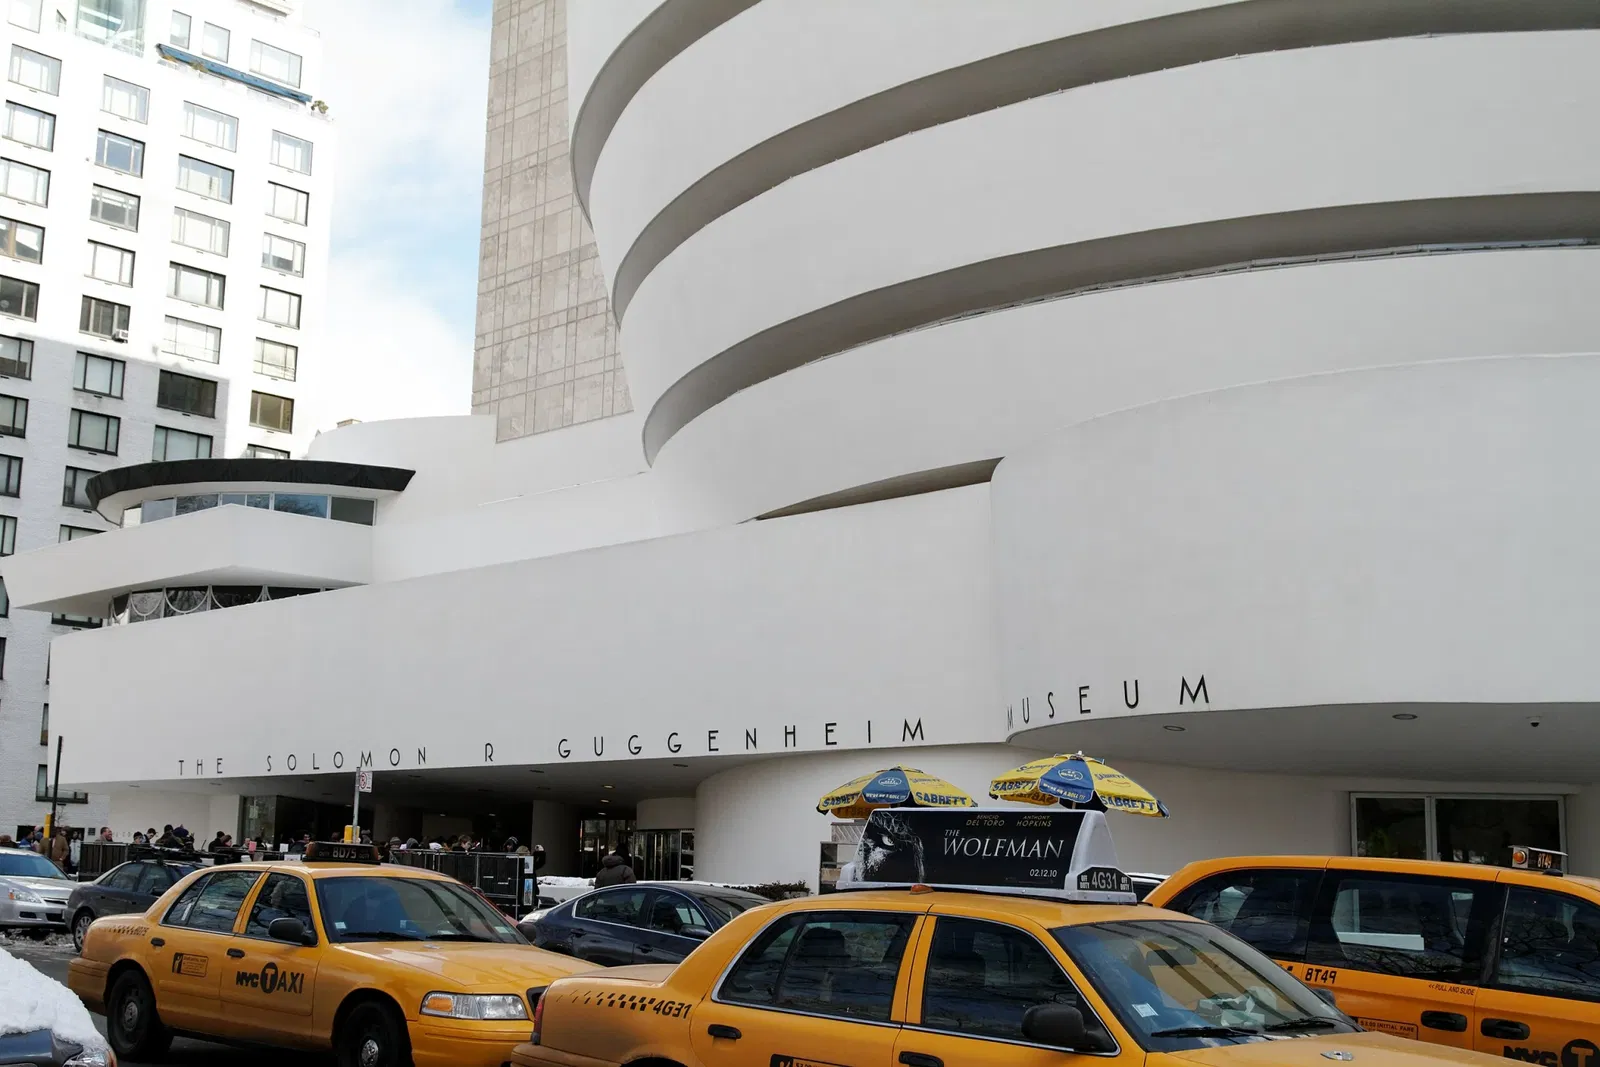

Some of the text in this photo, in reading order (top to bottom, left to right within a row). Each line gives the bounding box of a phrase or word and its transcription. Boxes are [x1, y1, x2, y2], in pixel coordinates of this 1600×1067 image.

[178, 674, 1210, 776] THE SOLOMON R GUGGENHEIM MUSEUM
[915, 791, 967, 805] SABRETT
[1099, 795, 1155, 811] SABRETT
[966, 819, 980, 827] DEL
[944, 829, 961, 837] THE
[943, 836, 1065, 860] WOLFMAN
[1029, 868, 1058, 878] 02.12.10
[1091, 871, 1118, 890] 4G31
[235, 962, 305, 994] NYC TAXI
[1304, 967, 1338, 985] 8T49
[1435, 983, 1448, 992] PULL
[1460, 987, 1475, 996] SLIDE
[652, 999, 693, 1019] 4G31
[1377, 1022, 1398, 1030] INITIAL
